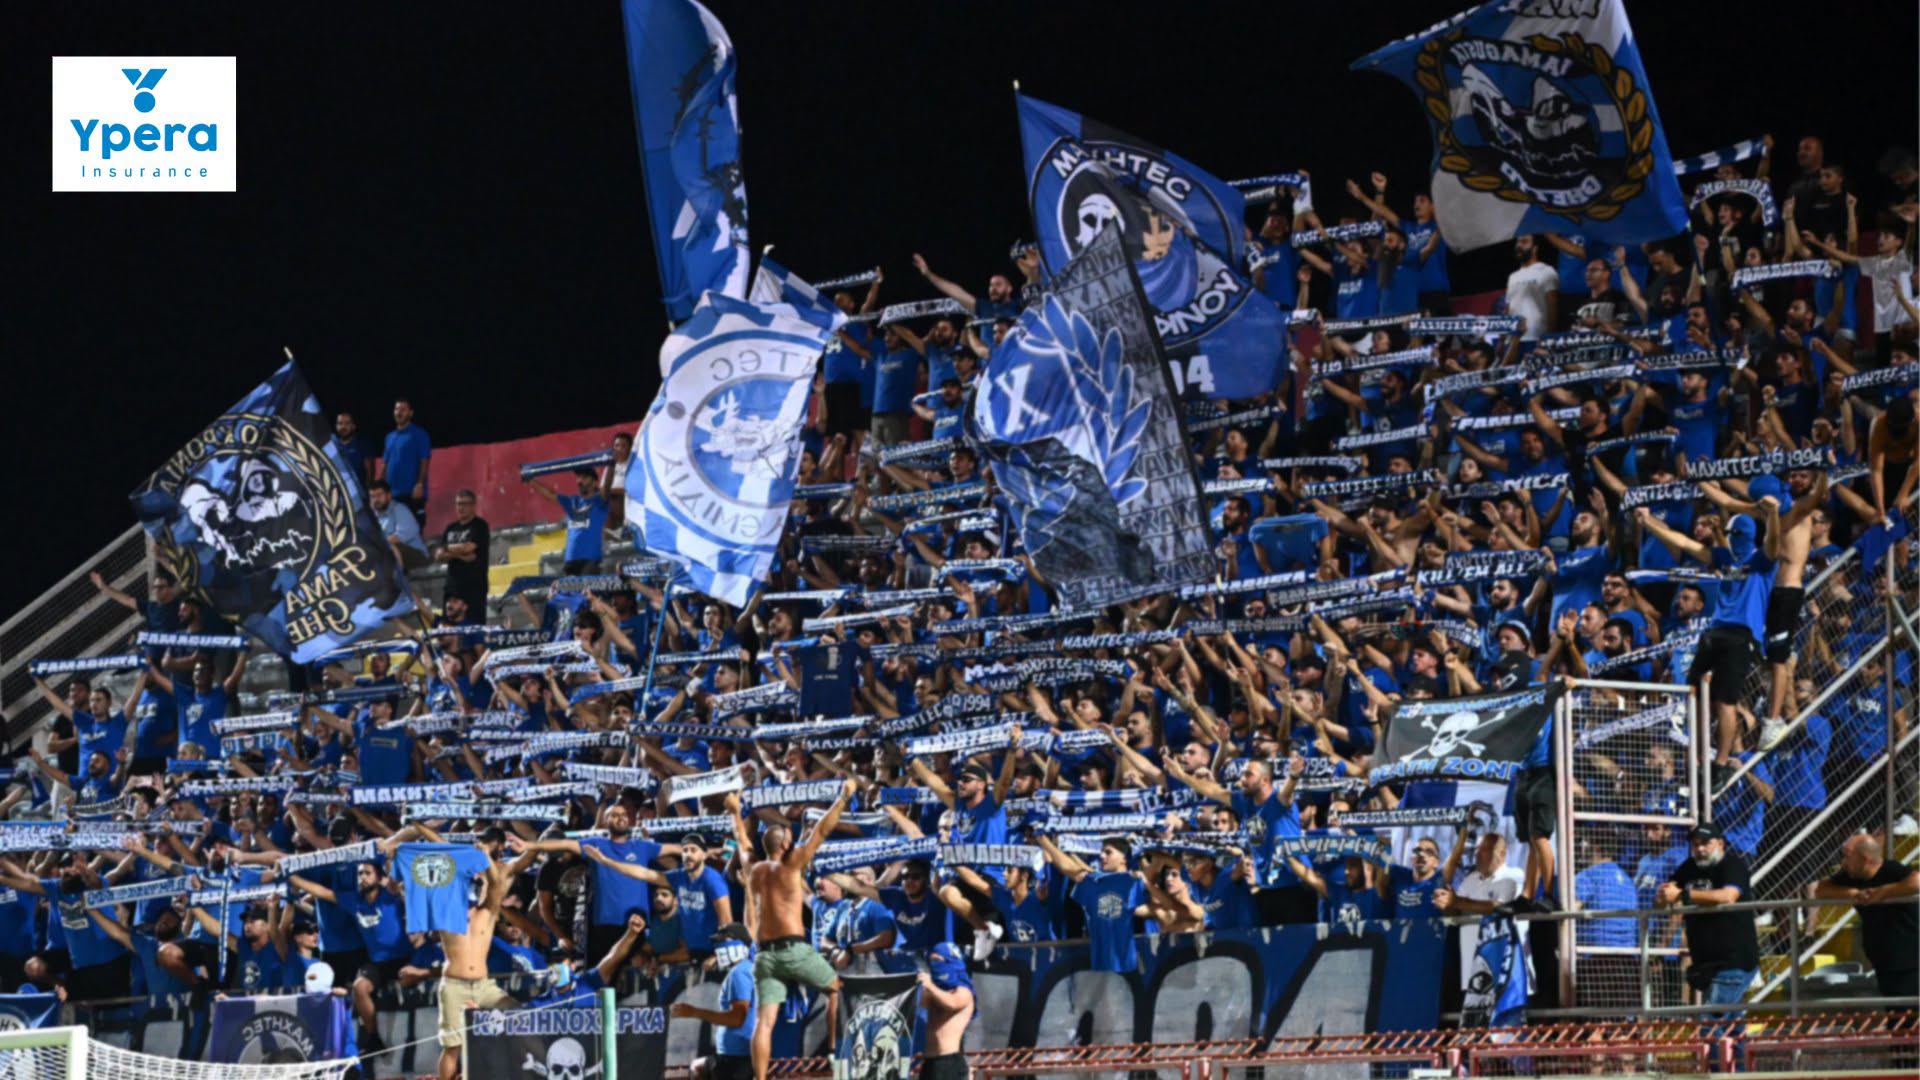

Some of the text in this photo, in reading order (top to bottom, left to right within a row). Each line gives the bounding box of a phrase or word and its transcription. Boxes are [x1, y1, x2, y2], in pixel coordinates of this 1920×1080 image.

[1686, 449, 1822, 475] MAXHTEC 1994
[1416, 568, 1456, 586] KILL
[137, 632, 241, 647] FAMAGUSTA
[1062, 631, 1128, 649] MAXHTEC
[37, 656, 138, 673] FAMAGUSTA
[962, 694, 991, 712] 1994
[412, 803, 561, 817] DEATH ZONE
[158, 819, 198, 834] ZNE
[280, 842, 376, 877] FAMAGUSTA
[471, 1006, 665, 1037] ΚΤΣΙΗΝΟΧΡΚΑ
